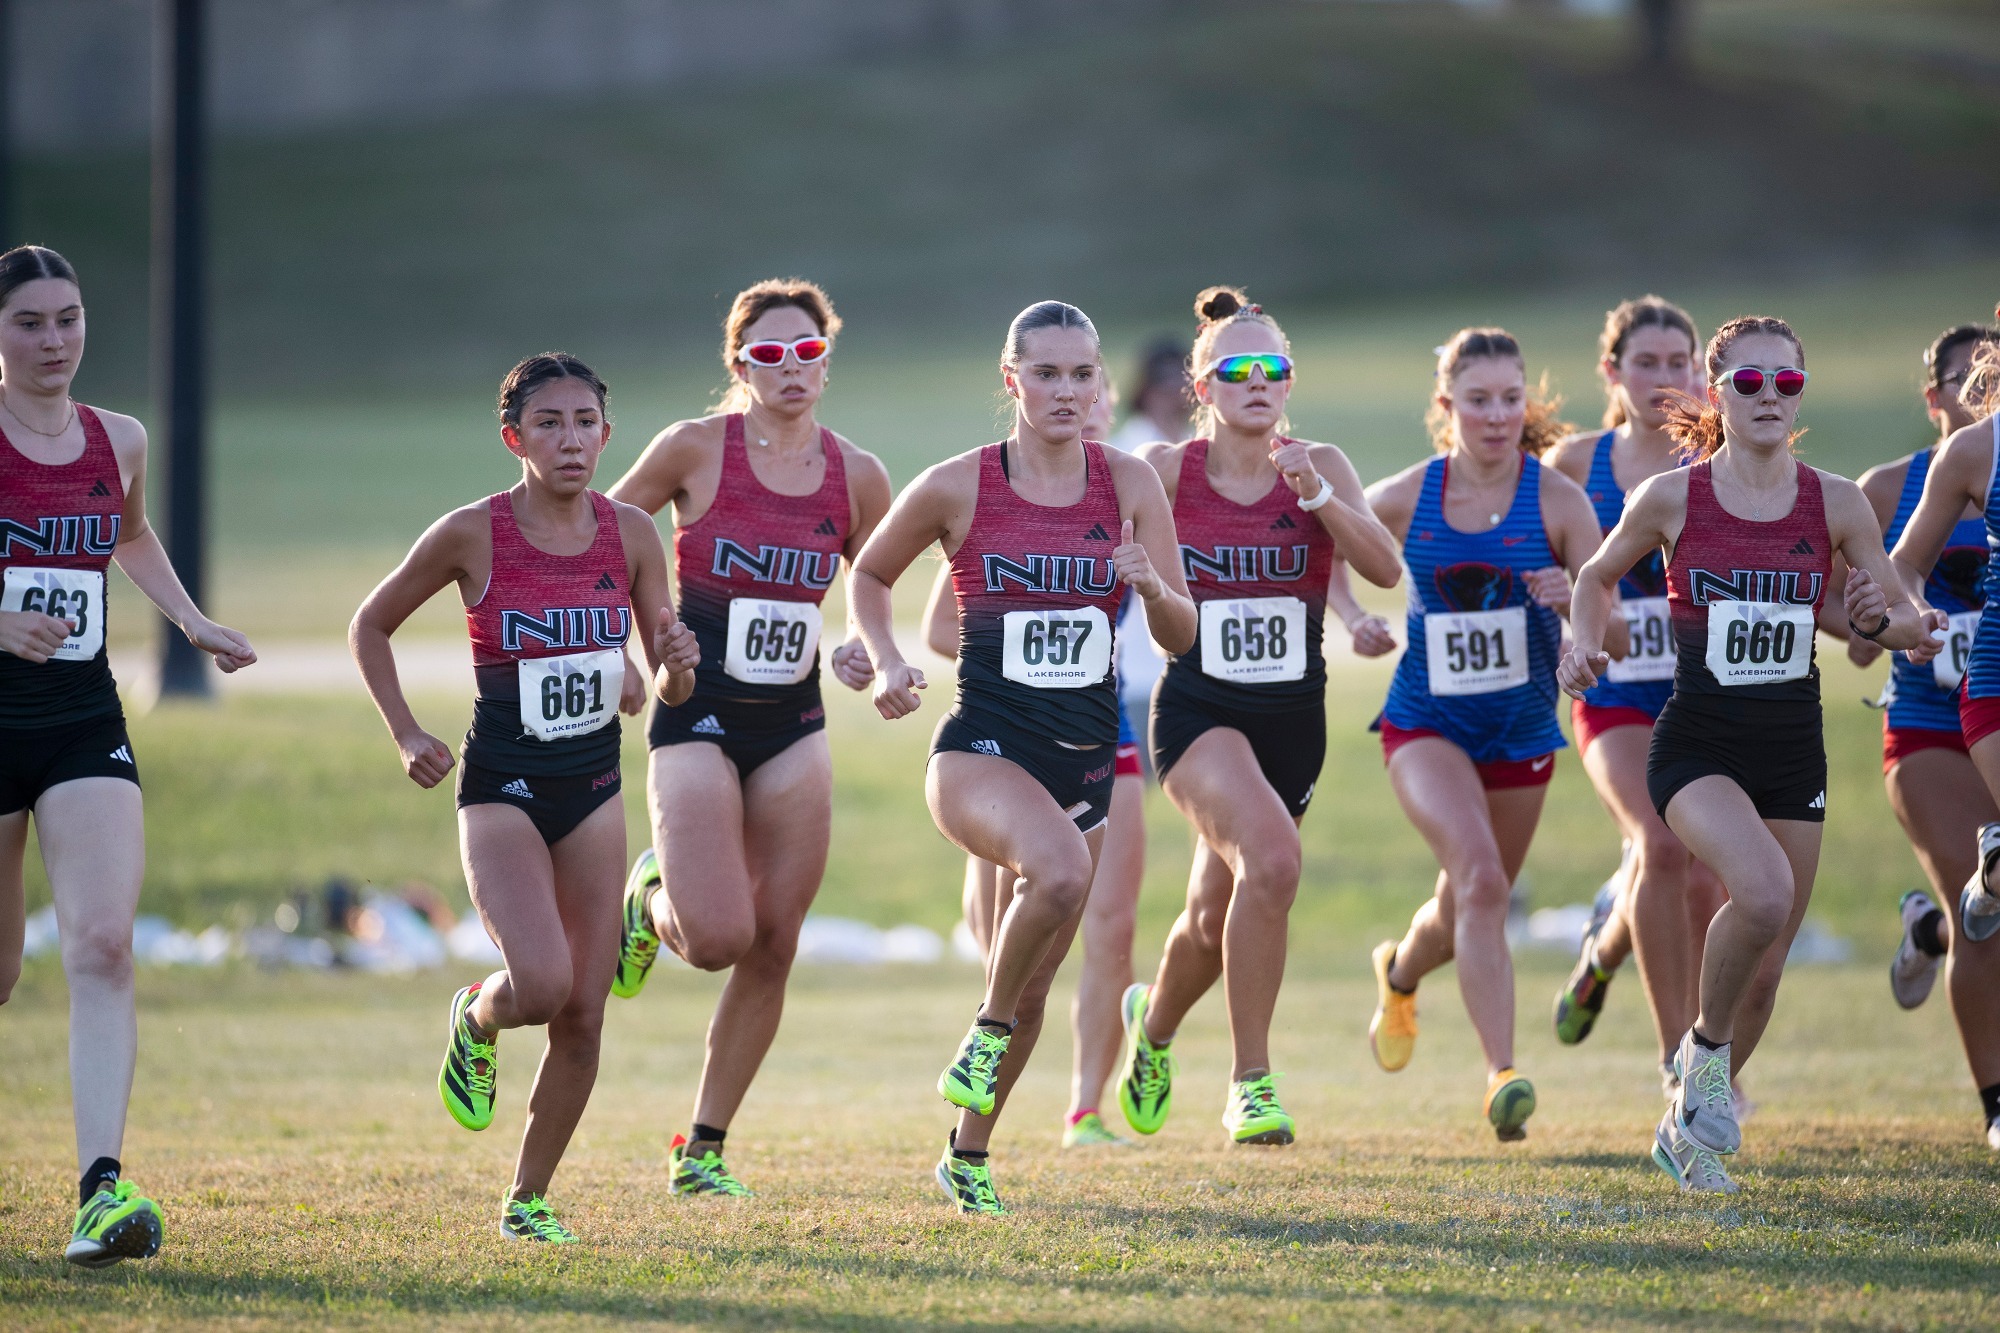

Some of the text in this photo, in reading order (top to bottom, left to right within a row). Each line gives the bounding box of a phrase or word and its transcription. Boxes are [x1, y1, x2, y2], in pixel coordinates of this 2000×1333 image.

[0, 514, 121, 558] NIU
[711, 537, 841, 590] NIU
[981, 553, 1119, 597] NIU
[1179, 544, 1309, 582] NIU
[1688, 568, 1824, 606] NIU
[501, 606, 631, 650] NIU
[745, 618, 807, 663] 659
[1023, 620, 1093, 666] 657
[1221, 615, 1287, 662] 658
[1445, 628, 1510, 672] 591
[1726, 619, 1795, 664] 660
[747, 667, 796, 675] LAKESHORE
[1226, 665, 1284, 674] LAKESHORE
[541, 669, 604, 721] 661
[545, 716, 601, 733] LAKESHORE
[501, 786, 534, 799] adidas
[592, 767, 620, 791] NIU
[1082, 761, 1111, 785] NIU
